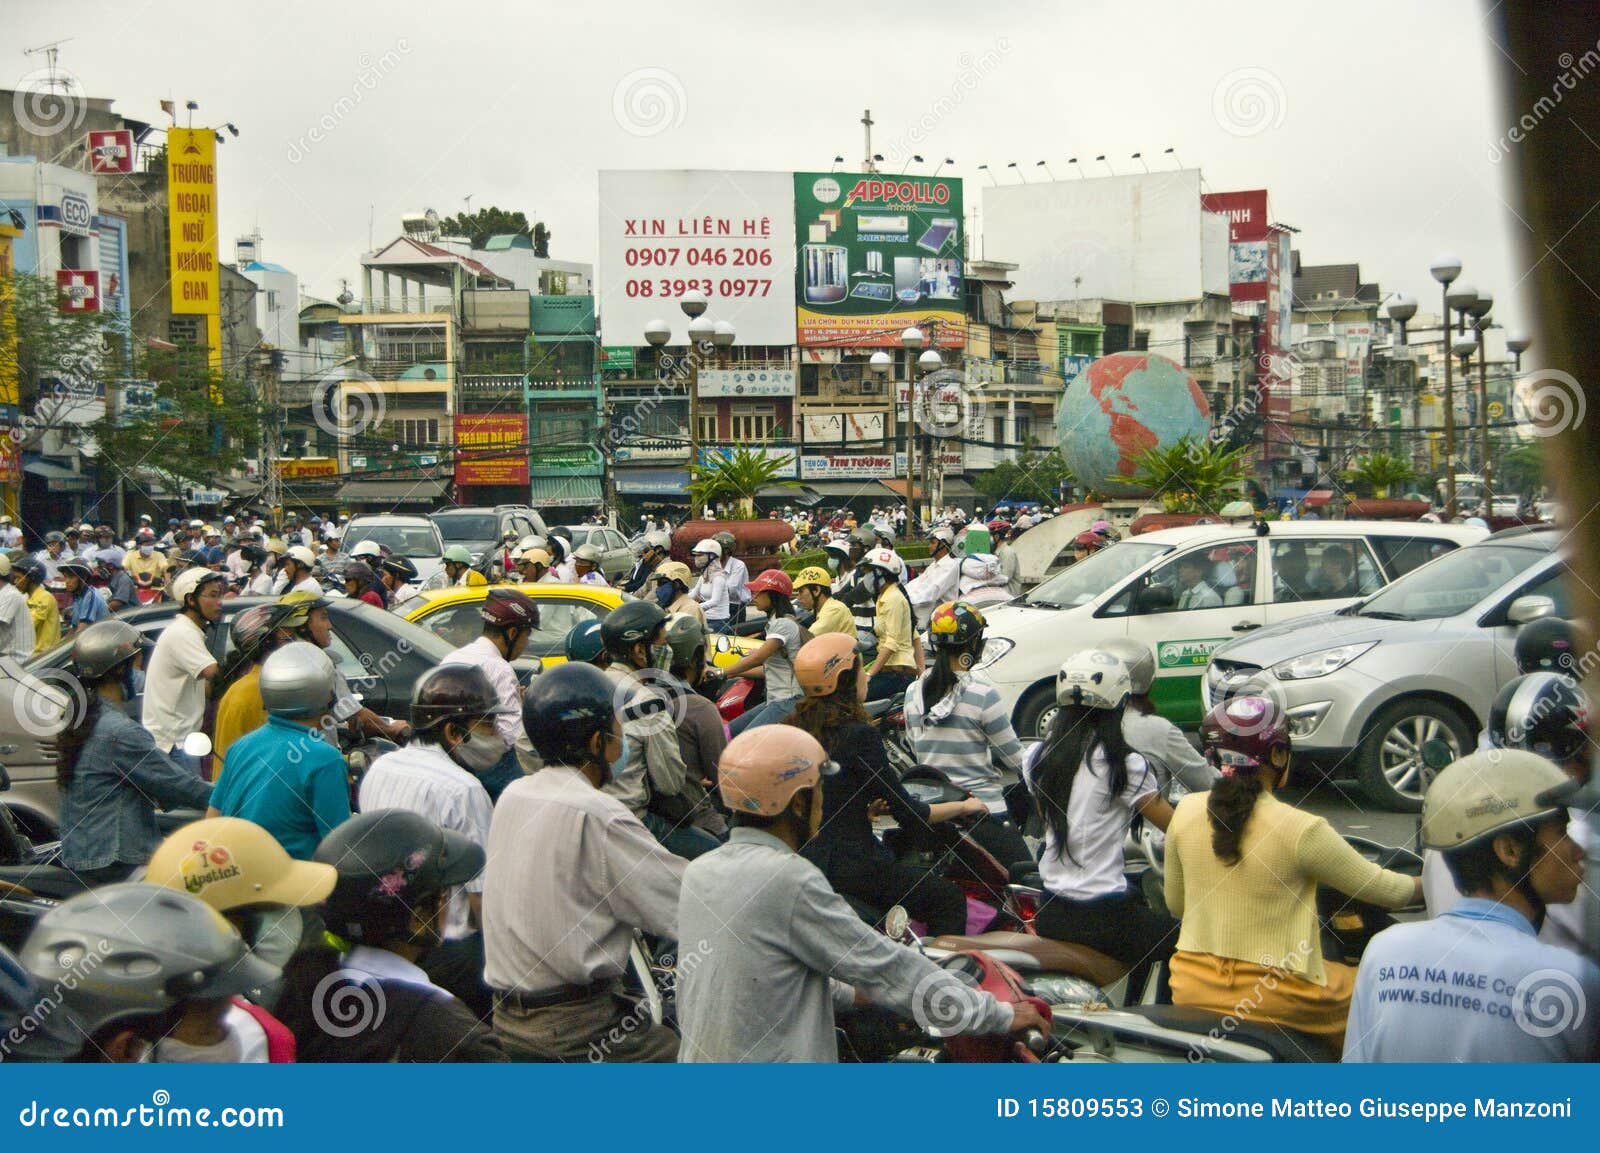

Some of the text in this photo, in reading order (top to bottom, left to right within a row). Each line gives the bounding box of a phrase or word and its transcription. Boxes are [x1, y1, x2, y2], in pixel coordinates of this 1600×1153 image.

[848, 179, 950, 204] APPOLLO
[65, 201, 87, 221] ECO
[177, 193, 210, 217] NGOẠI
[624, 216, 770, 240] XIN LIÊN HỆ
[177, 250, 213, 272] KHÔNG
[625, 248, 772, 266] 0907 046 206
[183, 281, 208, 301] GIAN
[625, 279, 653, 297] 08
[719, 279, 772, 297] 0977
[203, 854, 208, 867] I
[1379, 967, 1395, 982] SA
[1399, 966, 1420, 981] DA
[1425, 968, 1447, 983] NA
[1452, 971, 1488, 990] M&E
